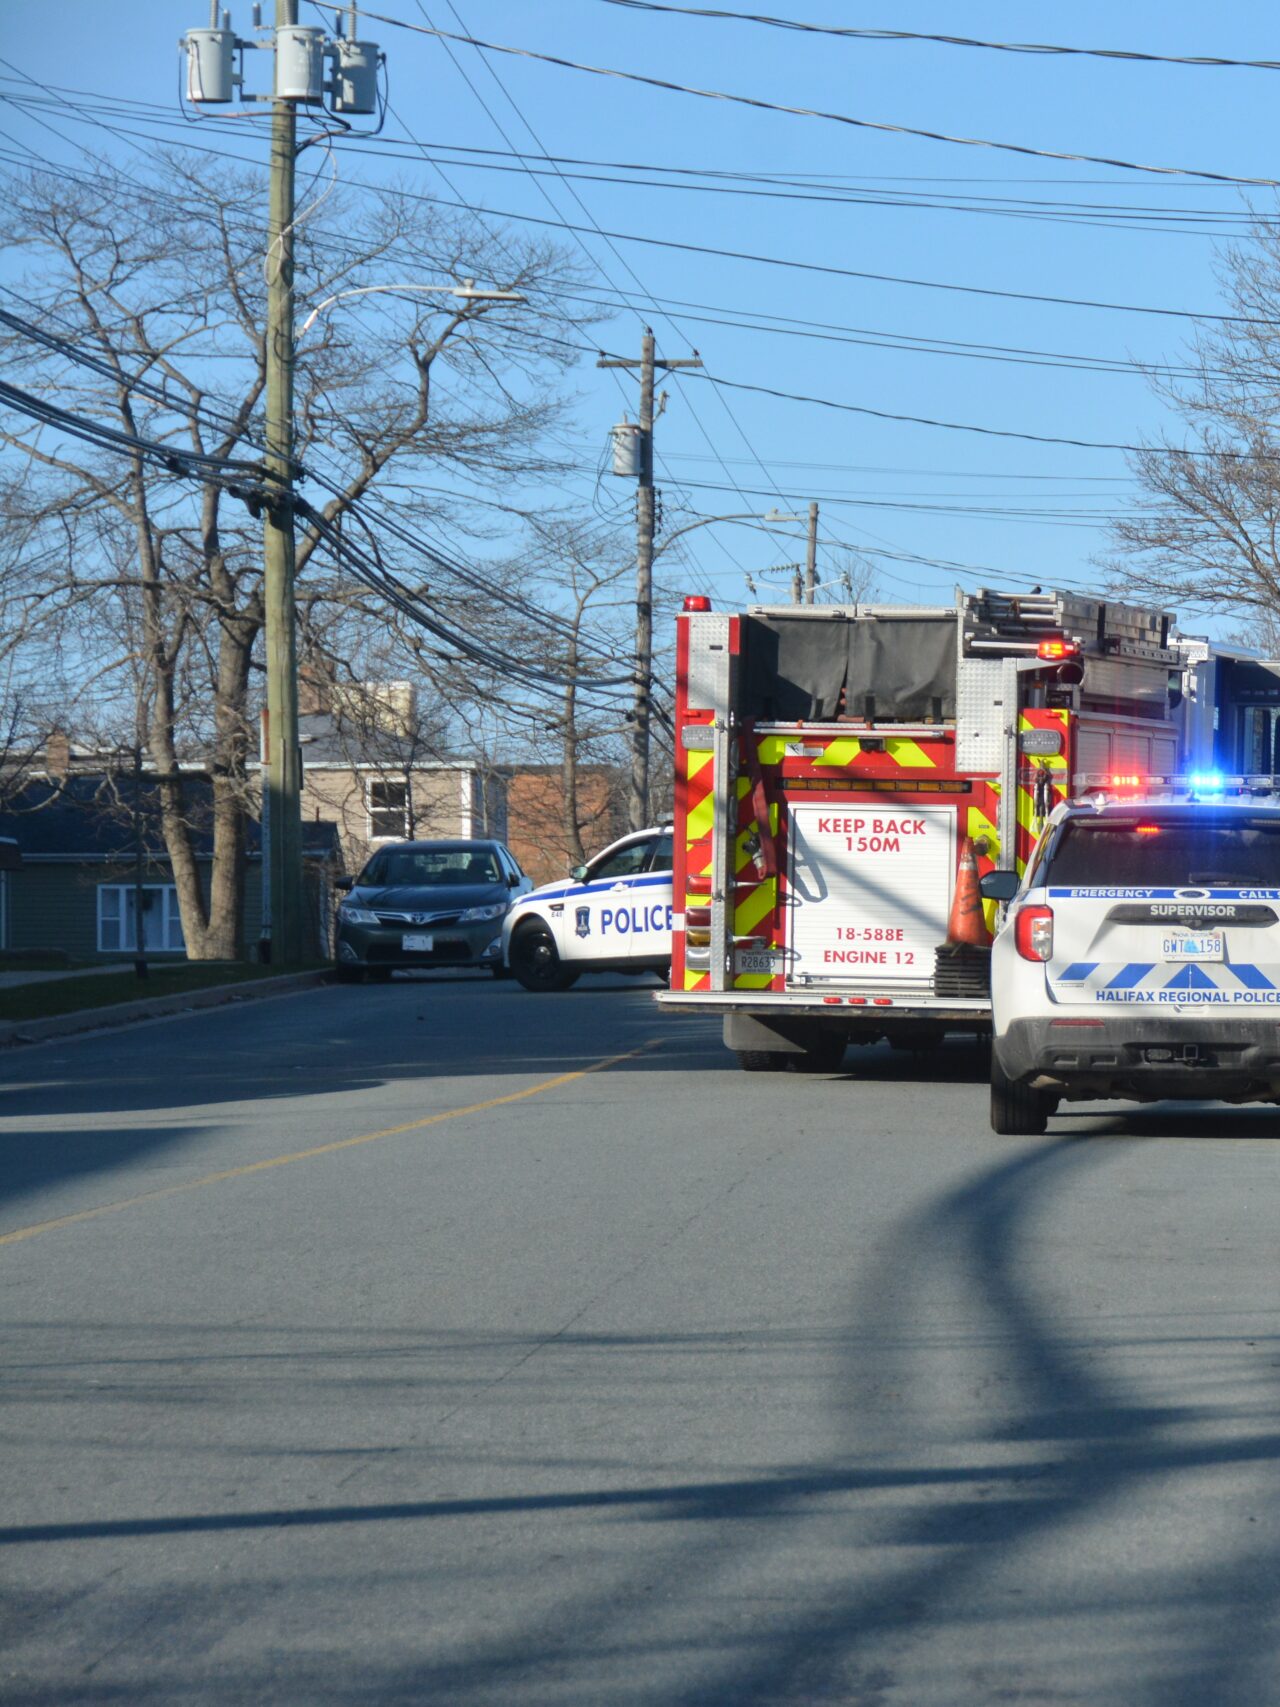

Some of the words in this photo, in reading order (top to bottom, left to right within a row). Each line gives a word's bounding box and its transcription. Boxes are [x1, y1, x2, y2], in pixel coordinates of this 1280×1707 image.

[818, 818, 866, 834] KEEP
[872, 819, 927, 835] BACK
[846, 836, 901, 853] 150M
[1070, 889, 1154, 898] EMERGENCY
[1238, 890, 1274, 899] CALL
[1150, 904, 1236, 917] SUPERVISOR
[601, 904, 673, 935] POLICE
[836, 927, 904, 941] 18-588E
[1163, 939, 1185, 953] GWT
[1200, 939, 1221, 953] 158
[823, 950, 887, 964] ENGINE
[895, 951, 914, 965] 12
[1096, 990, 1155, 1002] HALIFAX
[1159, 991, 1230, 1003] REGIONAL
